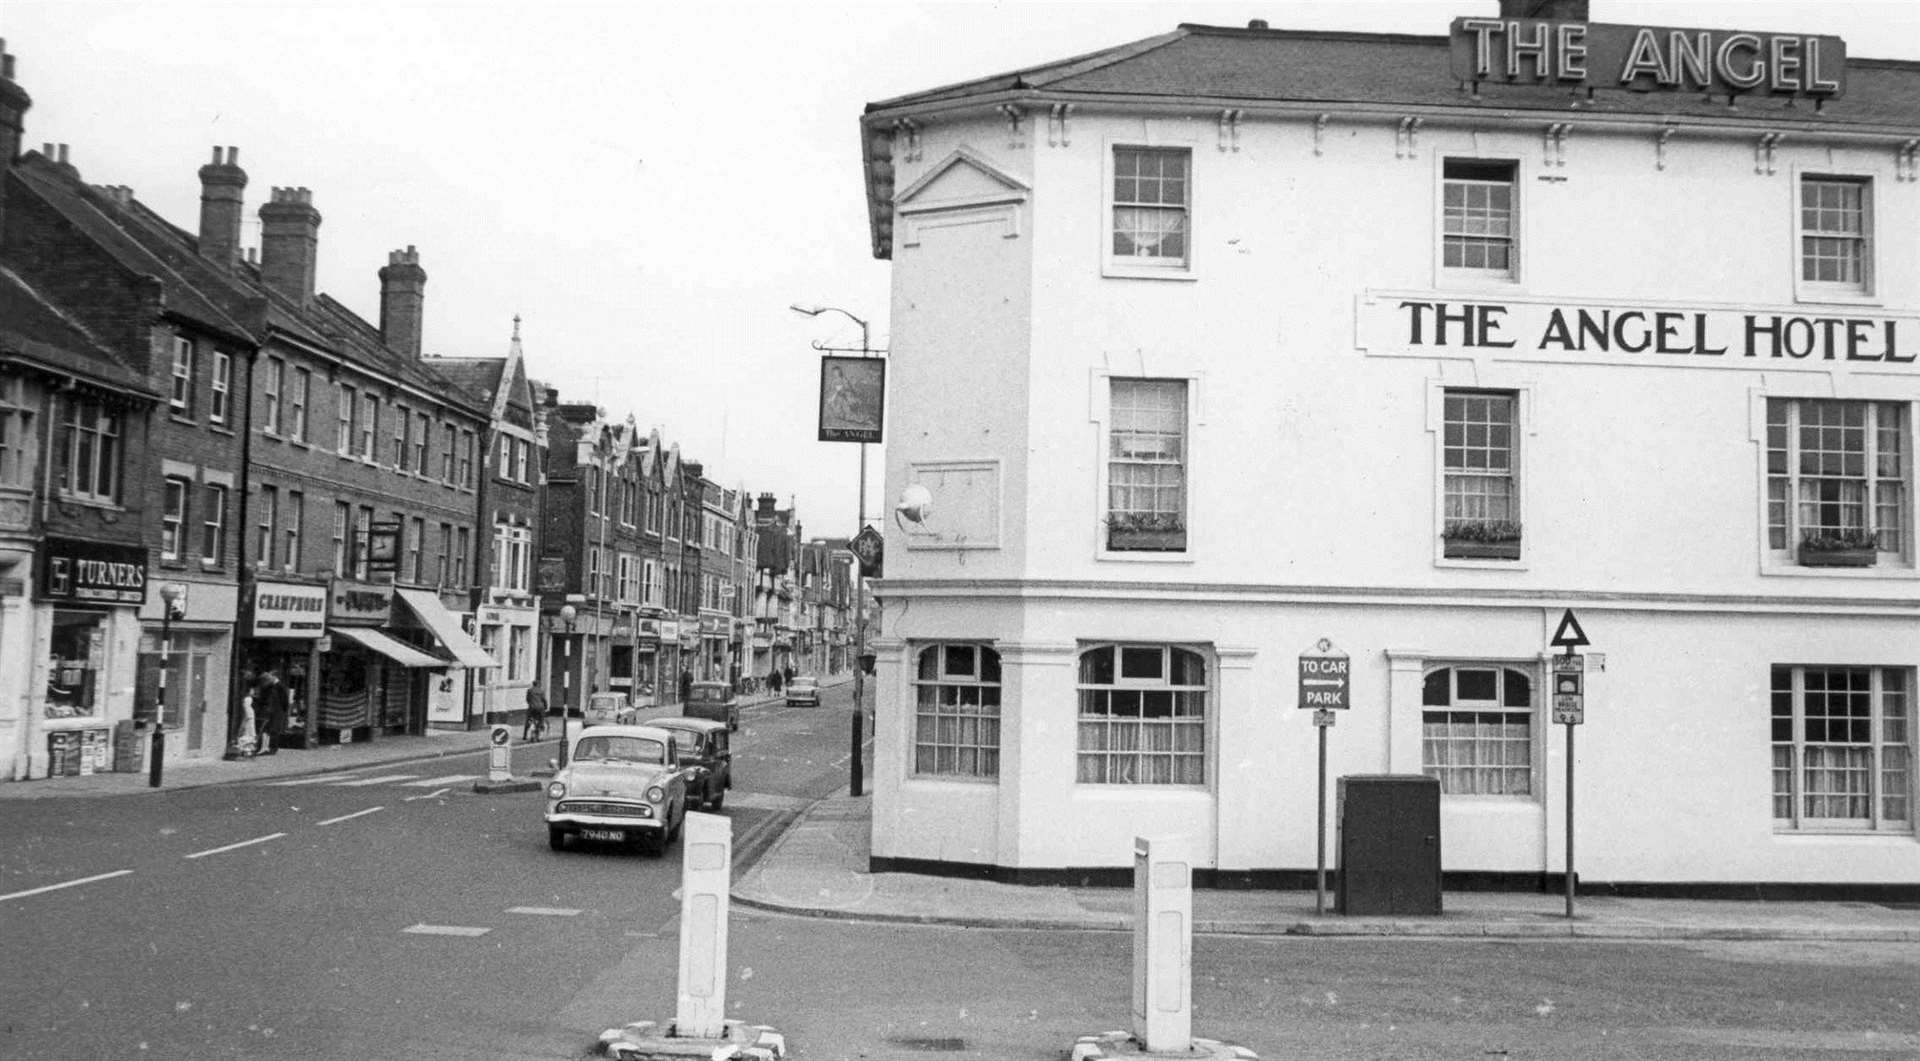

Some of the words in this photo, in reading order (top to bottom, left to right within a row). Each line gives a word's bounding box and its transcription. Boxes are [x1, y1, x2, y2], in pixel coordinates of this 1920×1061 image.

[1463, 19, 1587, 80] THE
[1620, 27, 1839, 95] ANGEL
[1399, 301, 1516, 348] THE
[1538, 308, 1727, 356] ANGEL
[1744, 315, 1917, 363] HOTEL
[78, 559, 144, 587] TURNERS
[1301, 660, 1318, 673] TO
[1320, 660, 1347, 673] CAR
[1307, 691, 1342, 704] PARK
